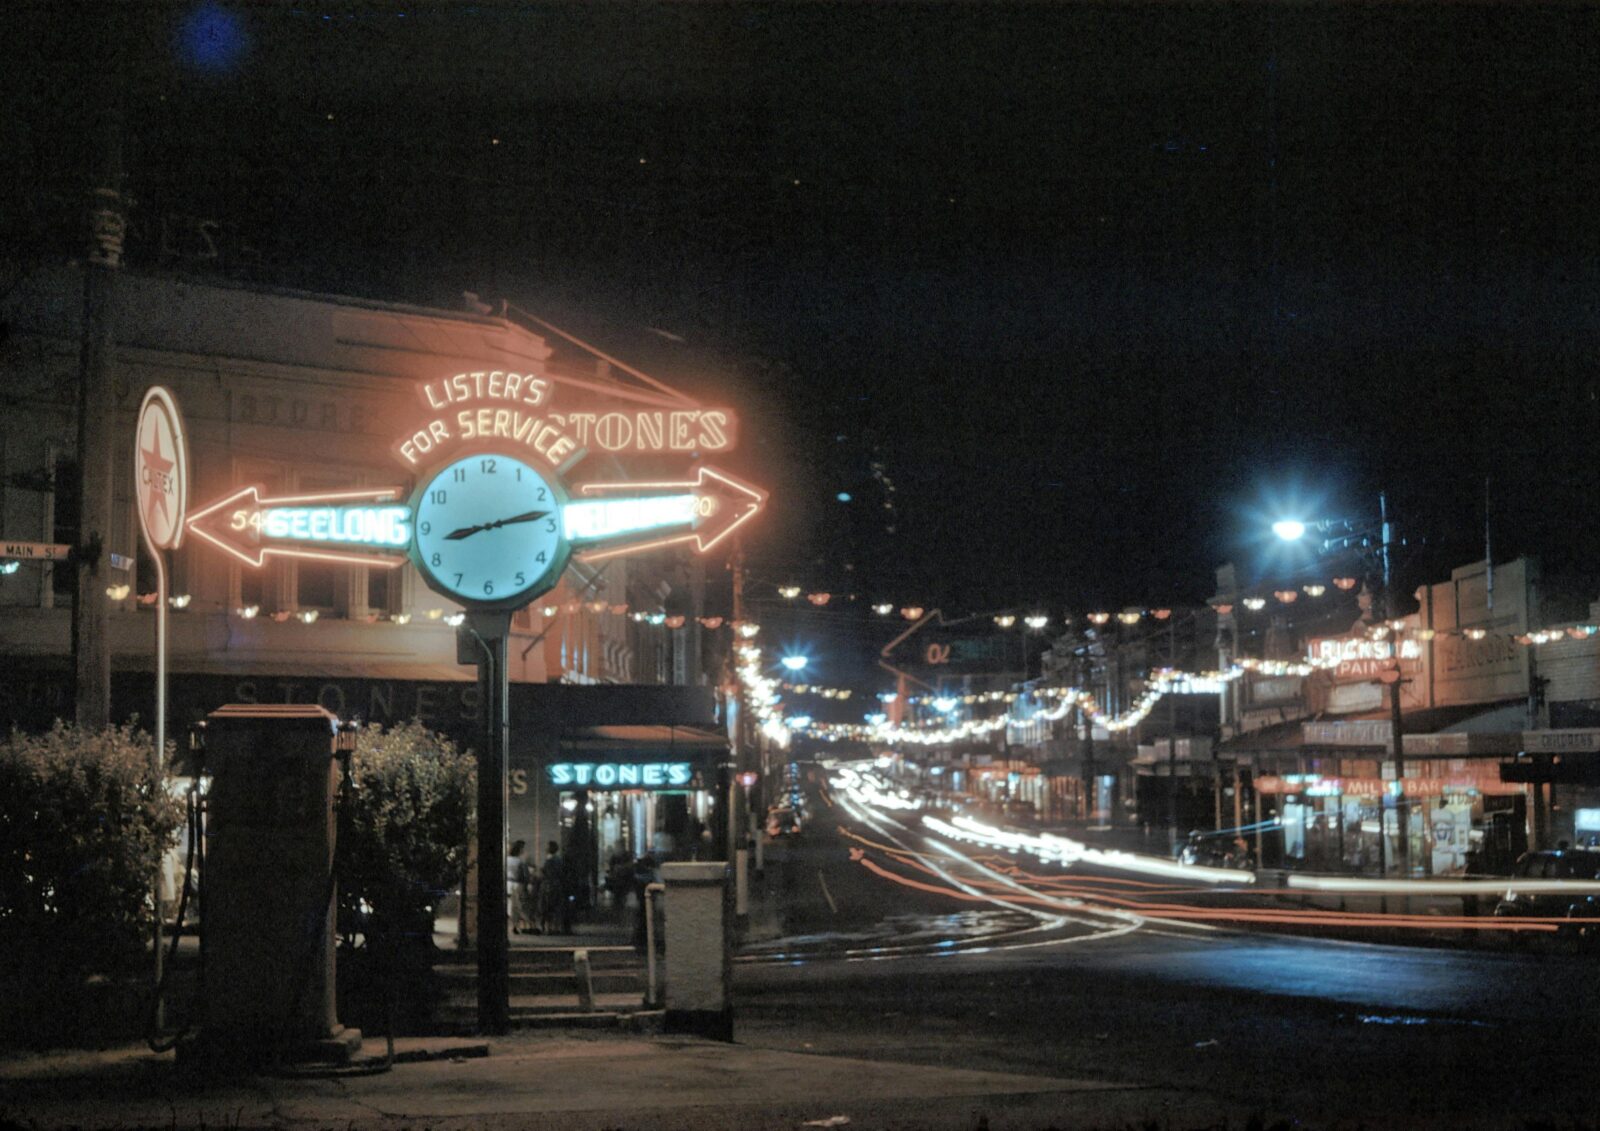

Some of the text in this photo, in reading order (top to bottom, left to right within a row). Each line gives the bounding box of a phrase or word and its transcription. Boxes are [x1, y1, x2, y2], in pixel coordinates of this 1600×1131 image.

[423, 371, 548, 410] LISTER'S
[399, 407, 577, 466] FOR SERVICE
[549, 409, 729, 451] TONE'S
[480, 459, 497, 475] 12
[454, 468, 466, 482] 11
[515, 468, 522, 482] 1
[430, 490, 447, 505] 10
[536, 487, 548, 502] 2
[231, 510, 261, 531] 54
[545, 518, 557, 533] 3
[420, 521, 432, 536] 9
[5, 545, 34, 557] MAIN
[535, 550, 548, 565] 4
[431, 552, 442, 567] 8
[454, 573, 465, 588] 7
[514, 571, 526, 587] 5
[483, 580, 495, 595] 6
[550, 763, 691, 785] STONE'S
[1407, 780, 1439, 793] BAR
